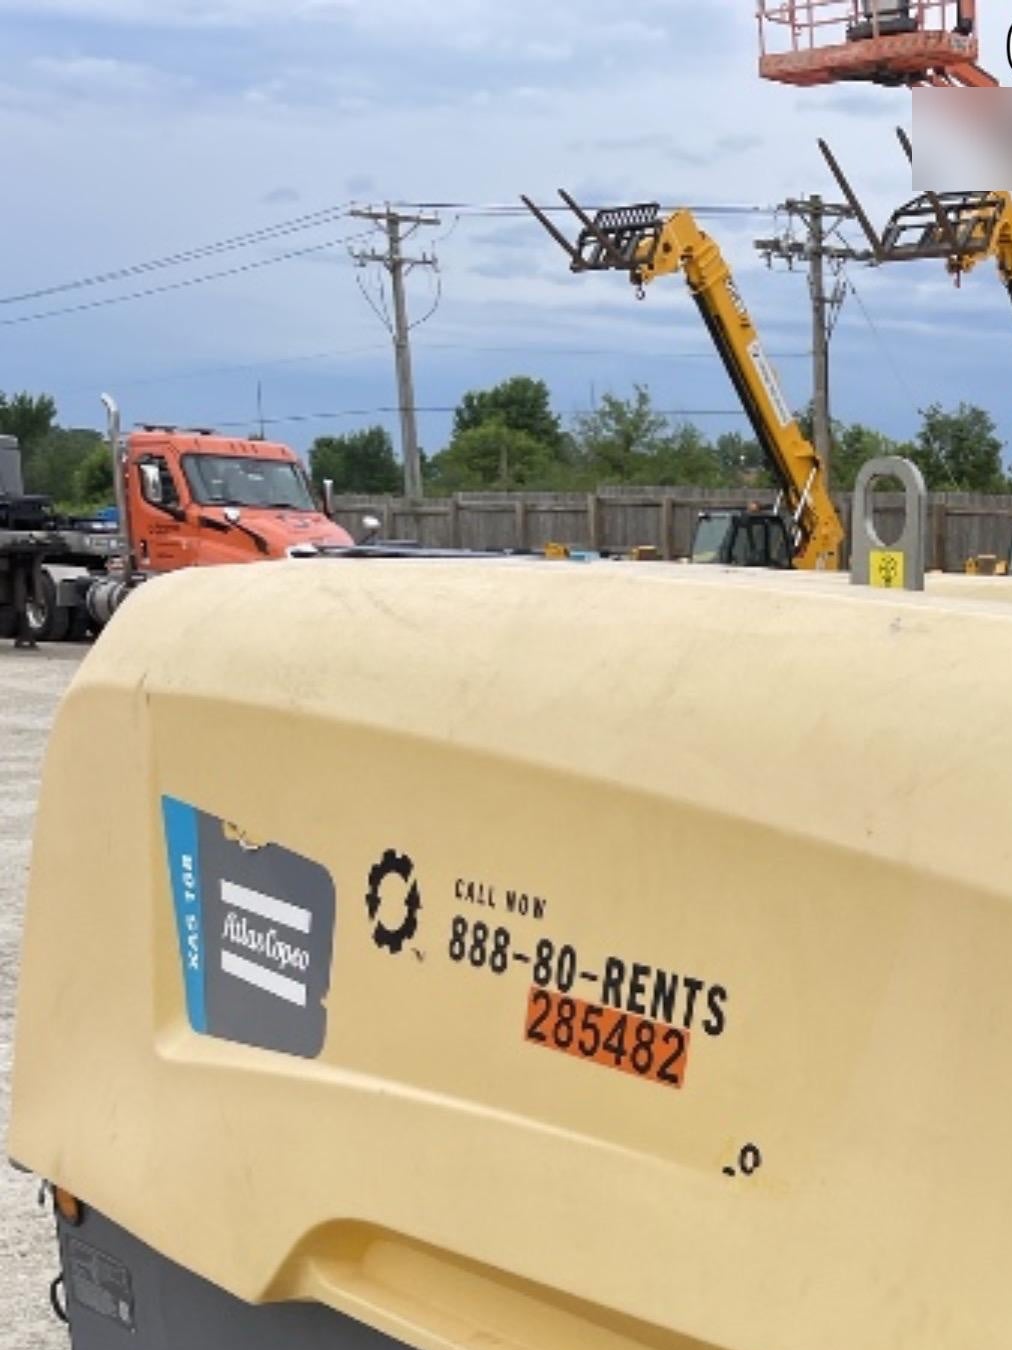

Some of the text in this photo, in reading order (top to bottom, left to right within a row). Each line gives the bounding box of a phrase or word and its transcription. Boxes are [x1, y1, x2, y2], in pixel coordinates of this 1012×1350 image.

[455, 878, 546, 919] CALL NOW
[449, 915, 728, 1036] 888-80-RENTS
[526, 990, 686, 1084] 285482
